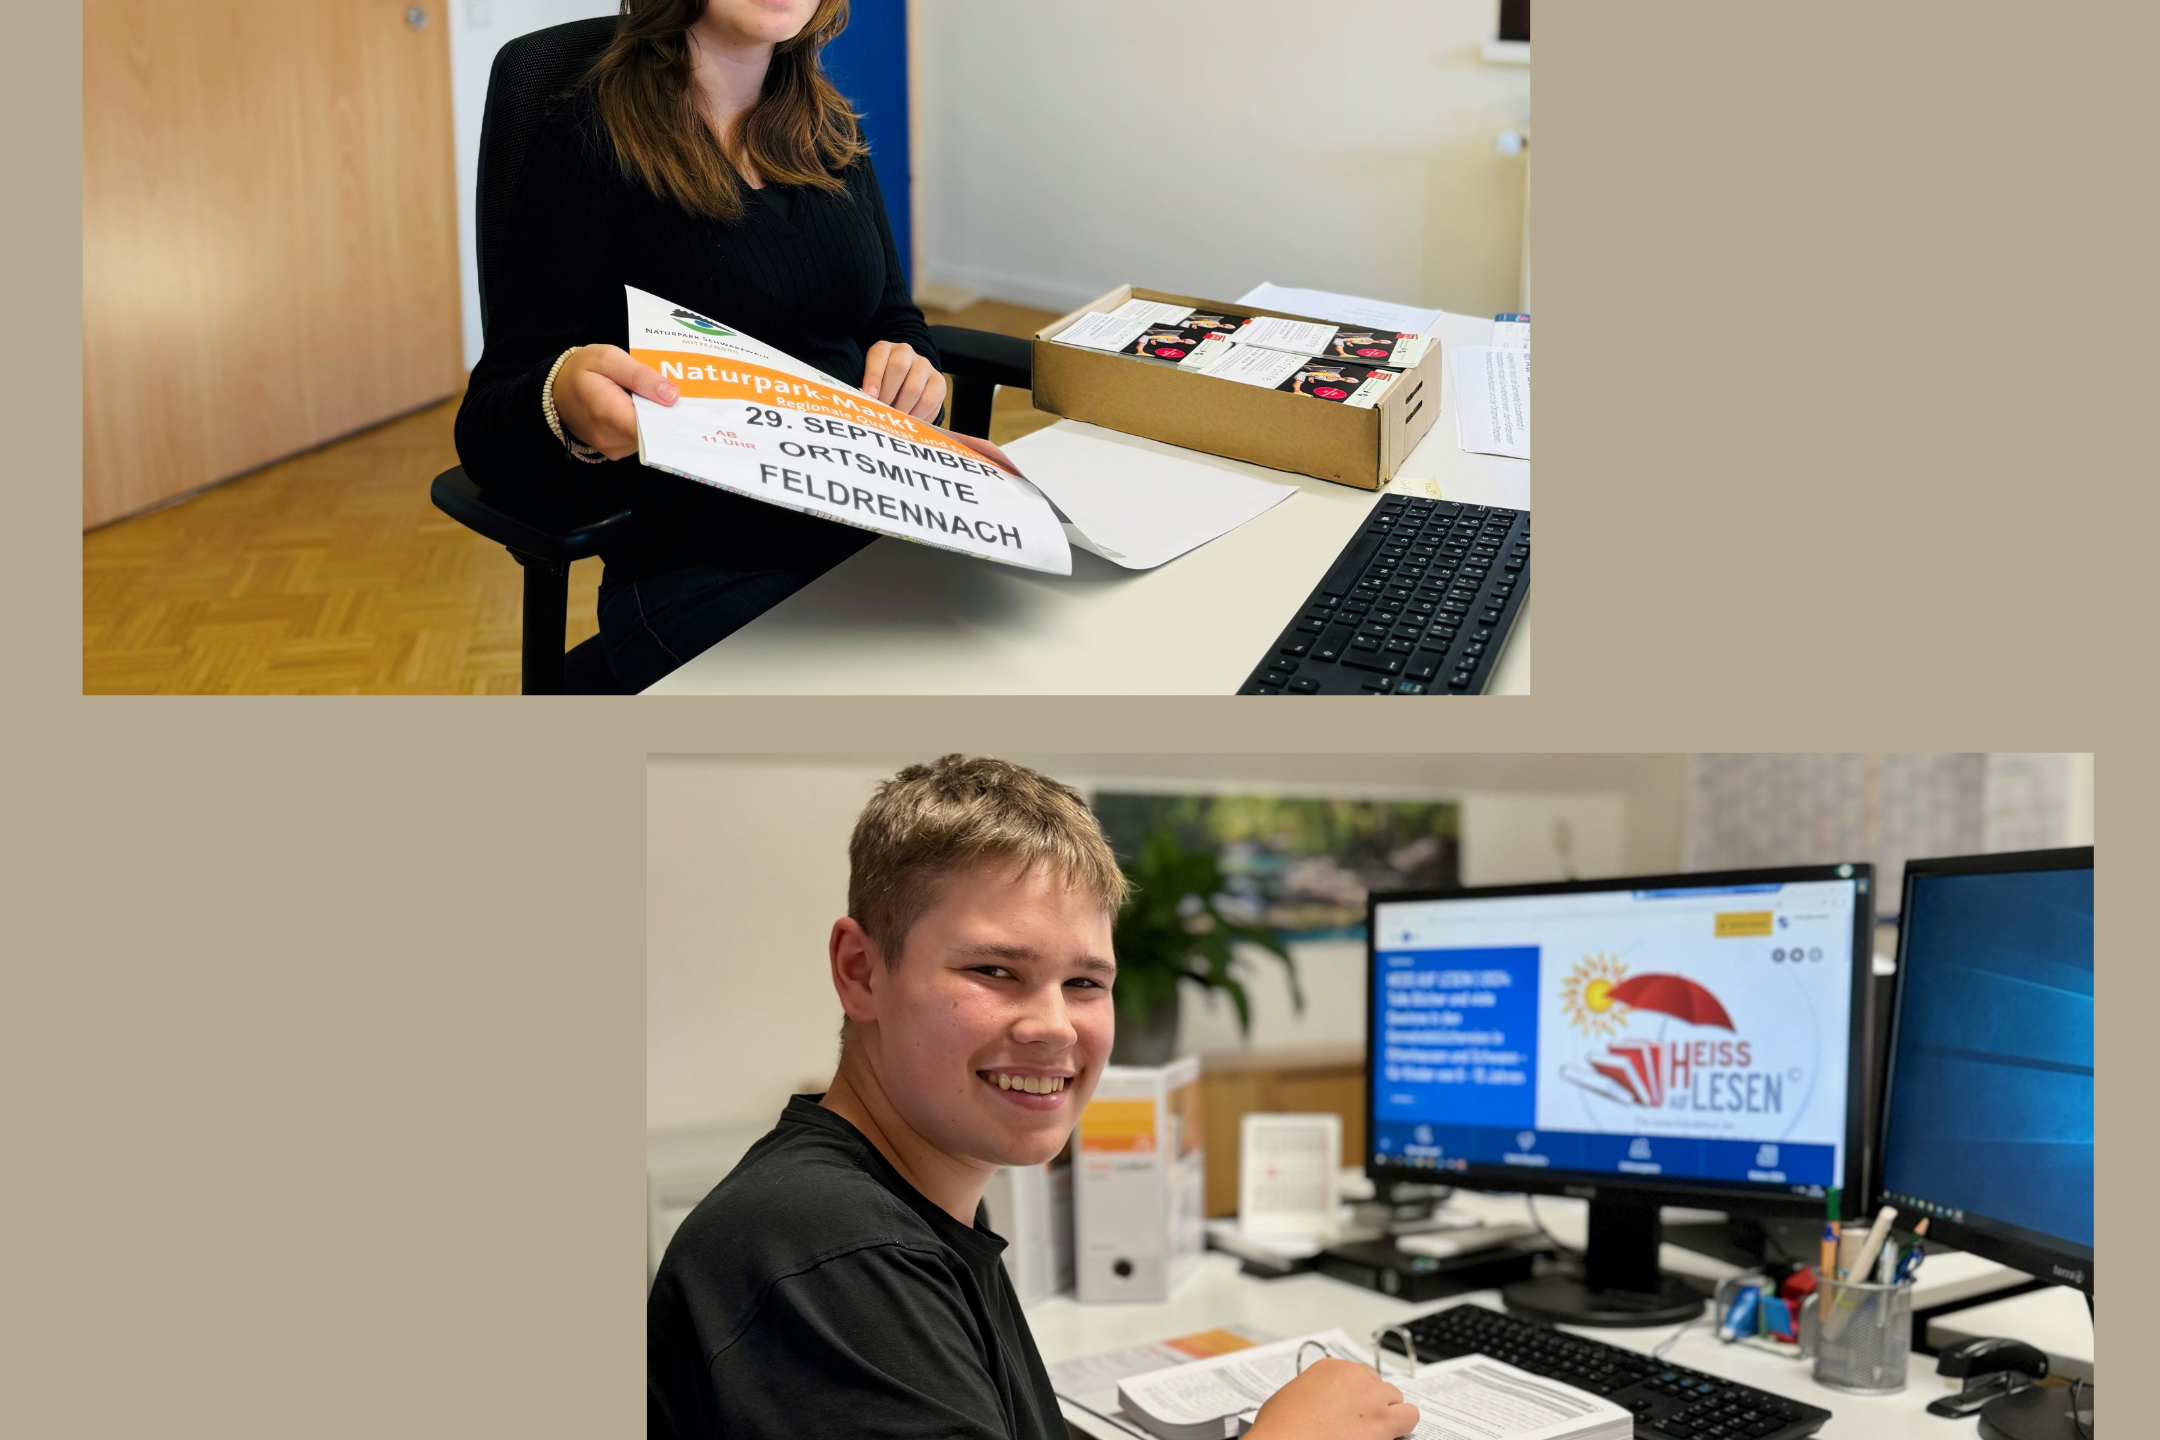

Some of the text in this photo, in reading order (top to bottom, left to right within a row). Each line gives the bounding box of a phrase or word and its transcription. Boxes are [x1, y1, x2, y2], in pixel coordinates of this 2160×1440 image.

[682, 339, 739, 355] MITTE/NORD
[660, 360, 919, 433] Naturpark-Markt
[701, 435, 757, 451] 11 UHR
[716, 429, 738, 440] AB
[745, 405, 1005, 481] 29. SEPTEMBER
[777, 397, 852, 421] Regionale
[856, 415, 916, 441] Qualität
[920, 435, 948, 449] und
[779, 441, 979, 505] ORTSMITTE
[760, 464, 1023, 550] FELDRENNACH
[1669, 1040, 1752, 1089] HEISS
[1692, 1072, 1783, 1114] LESEN
